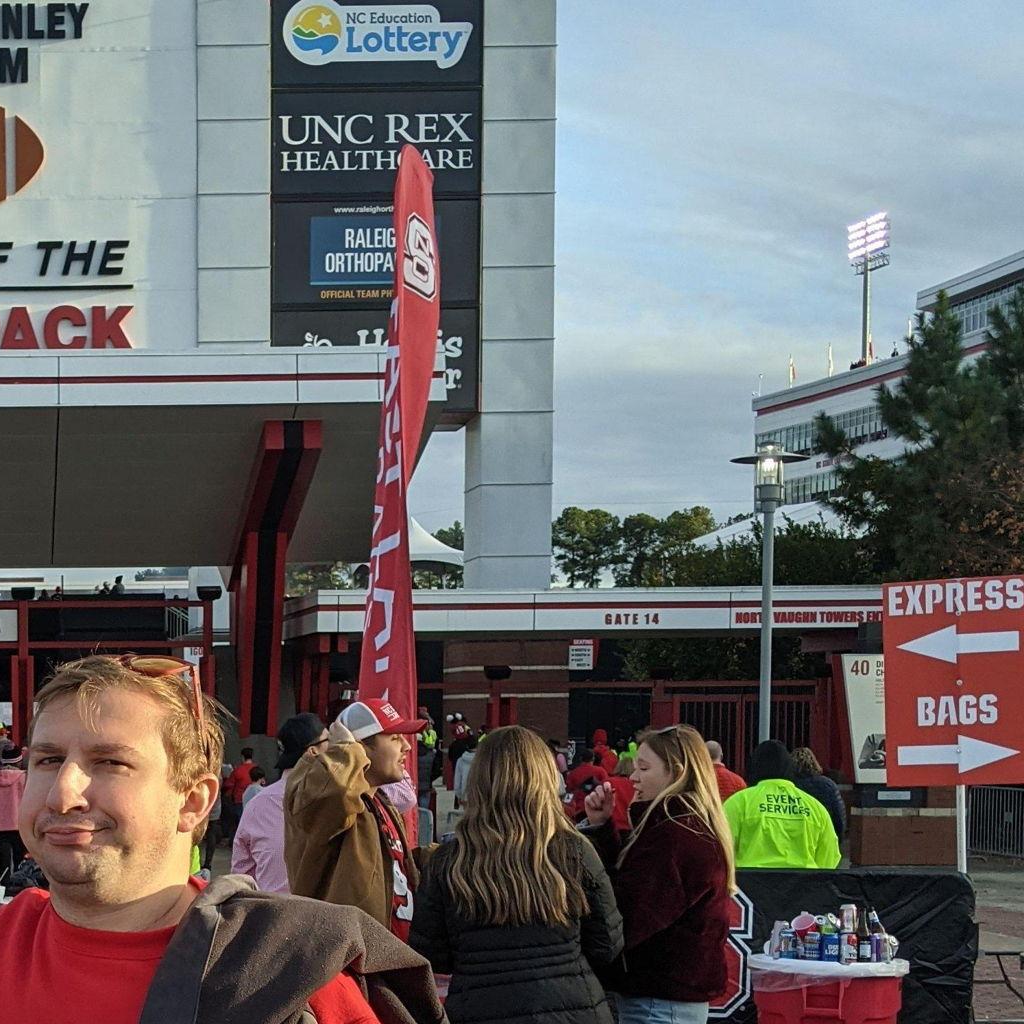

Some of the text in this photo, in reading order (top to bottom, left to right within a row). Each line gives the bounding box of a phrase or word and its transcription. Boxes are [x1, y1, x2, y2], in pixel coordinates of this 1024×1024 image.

[346, 12, 433, 24] NC Education
[346, 26, 463, 60] Lottery
[278, 113, 474, 145] UNC REX
[280, 148, 474, 172] HEALTHARE
[344, 227, 396, 248] RALEIG
[36, 240, 130, 276] THE
[325, 252, 396, 273] ORTHOPA
[320, 290, 355, 299] OFFICIAL
[357, 290, 380, 298] TEAM
[888, 578, 1024, 617] EXPRESS
[604, 613, 660, 625] GATE 14
[735, 612, 763, 624] NORT
[819, 611, 864, 623] TOWERS
[850, 660, 870, 676] 40
[917, 693, 998, 727] BAGS
[759, 803, 811, 817] SERVICES
[766, 794, 802, 806] EVENT
